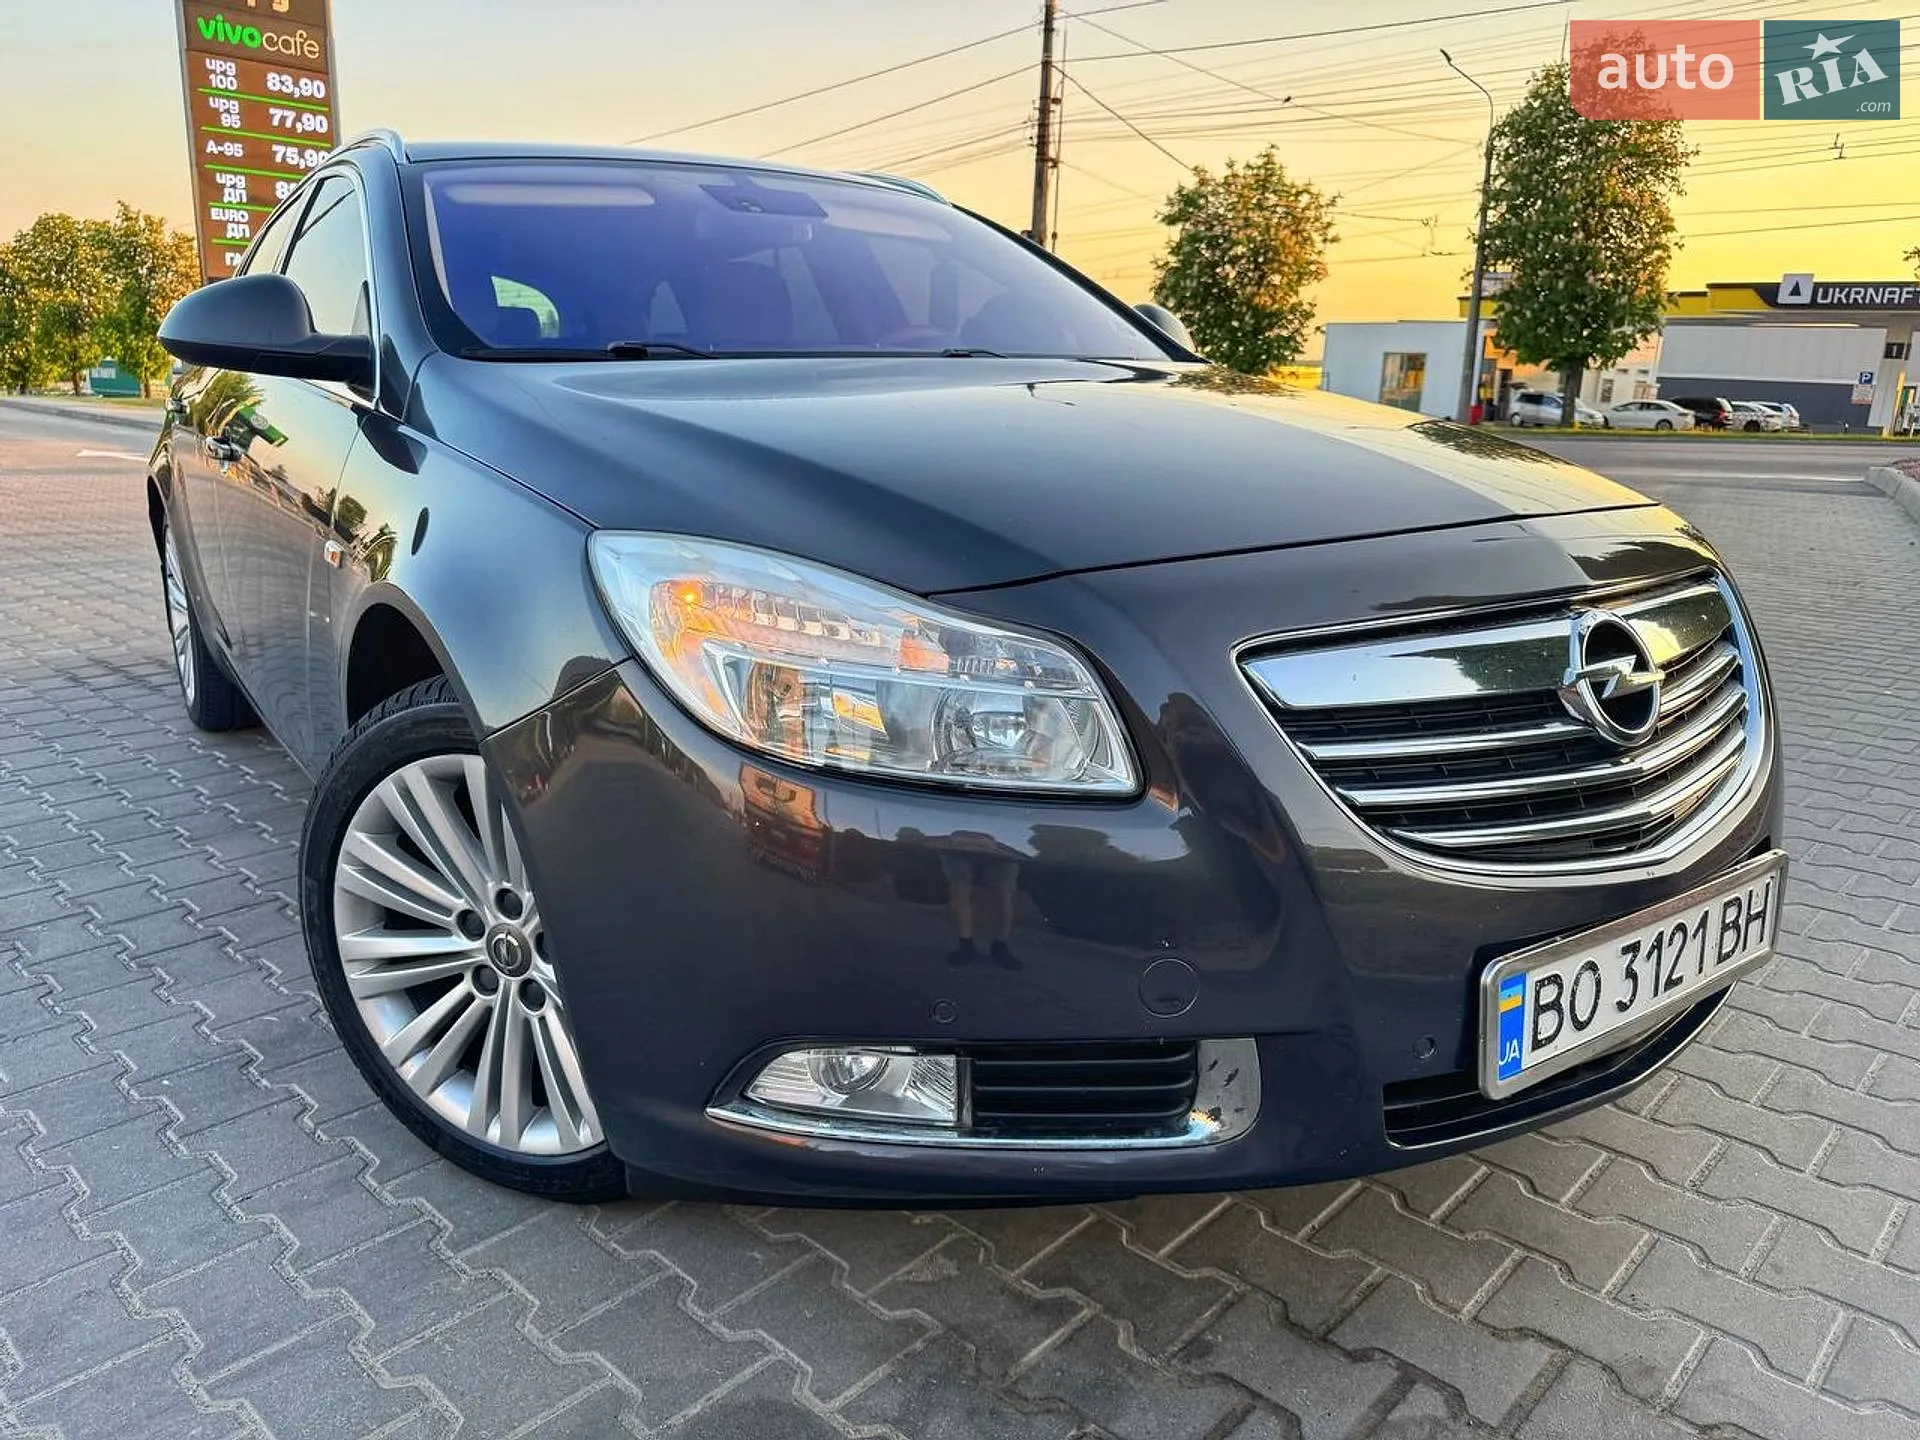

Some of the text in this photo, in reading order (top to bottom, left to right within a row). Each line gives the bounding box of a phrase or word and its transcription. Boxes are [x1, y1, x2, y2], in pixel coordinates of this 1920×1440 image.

[206, 58, 236, 76] upg
[208, 75, 238, 91] 100
[266, 72, 326, 98] 83,90
[209, 96, 239, 114] upg
[220, 113, 241, 129] 95
[269, 108, 328, 133] 77,90
[215, 173, 246, 189] upg
[211, 207, 249, 222] EURO
[1531, 959, 1602, 1053] BO
[1615, 908, 1711, 1012] 3121
